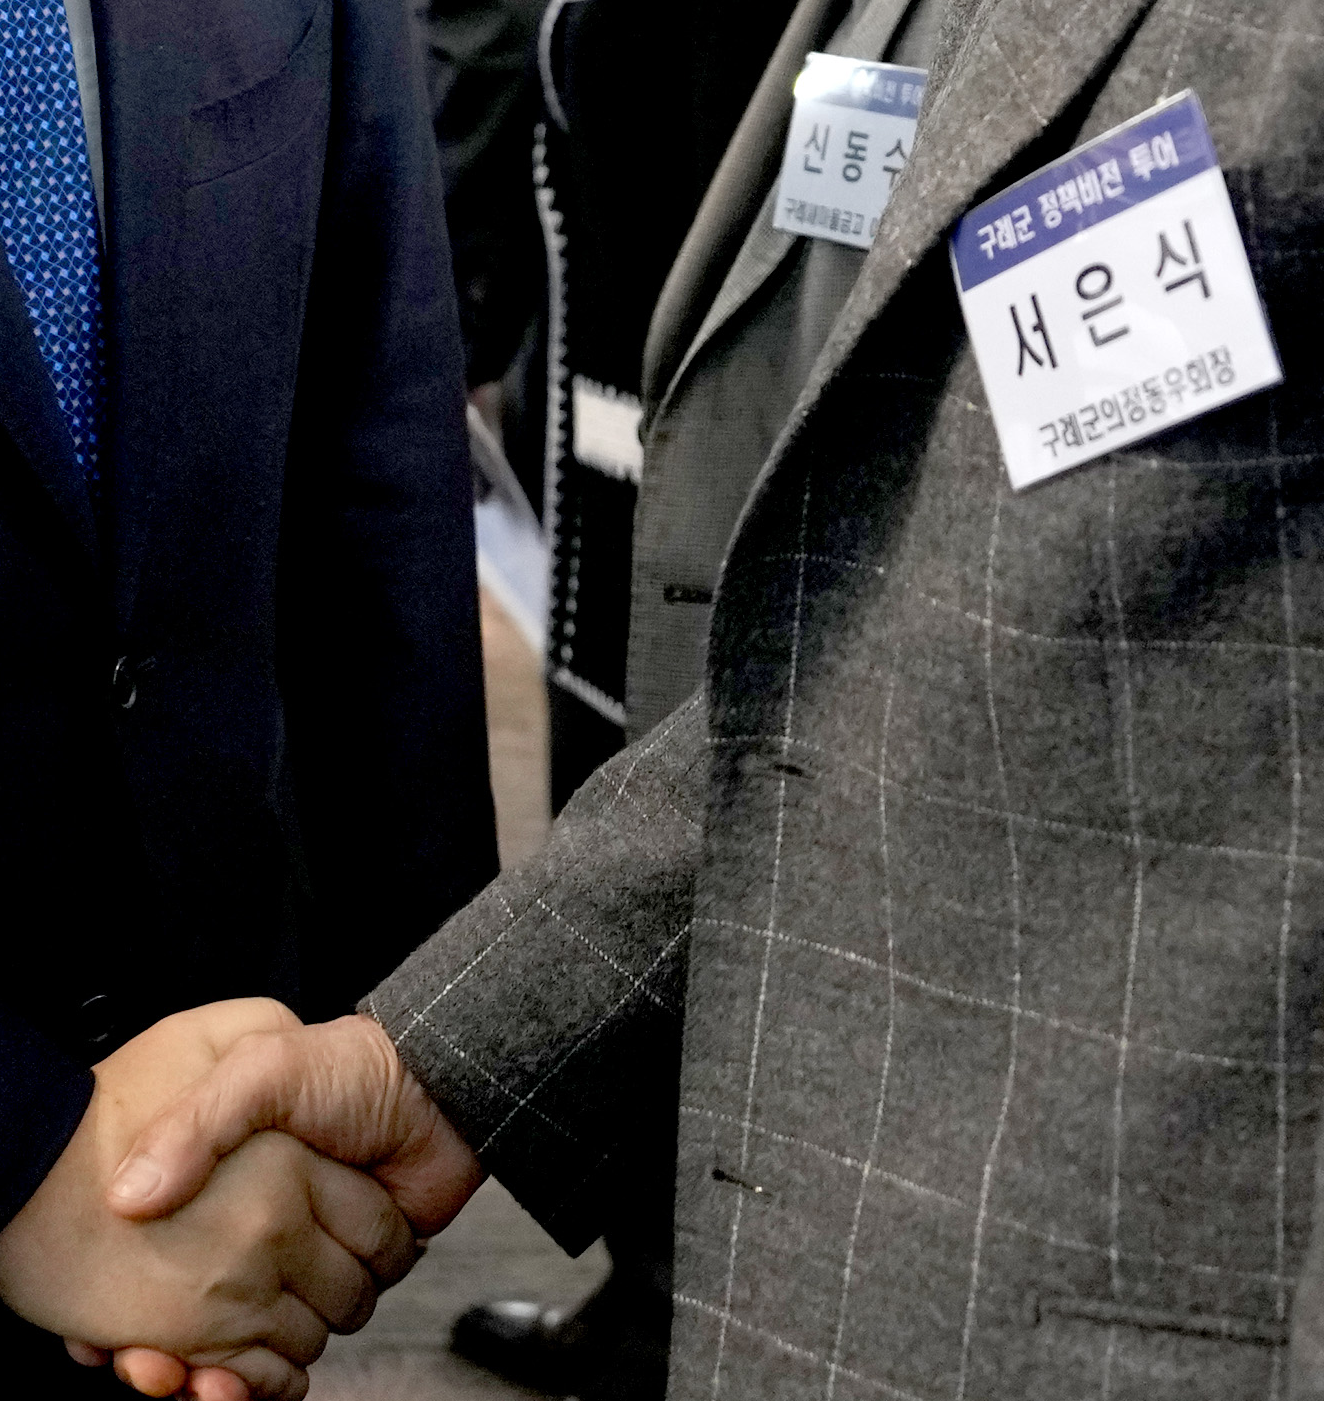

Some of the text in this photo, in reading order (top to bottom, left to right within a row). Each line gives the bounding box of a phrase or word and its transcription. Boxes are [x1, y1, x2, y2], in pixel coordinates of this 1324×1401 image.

[976, 130, 1180, 261] 구례군 정책비전 투어
